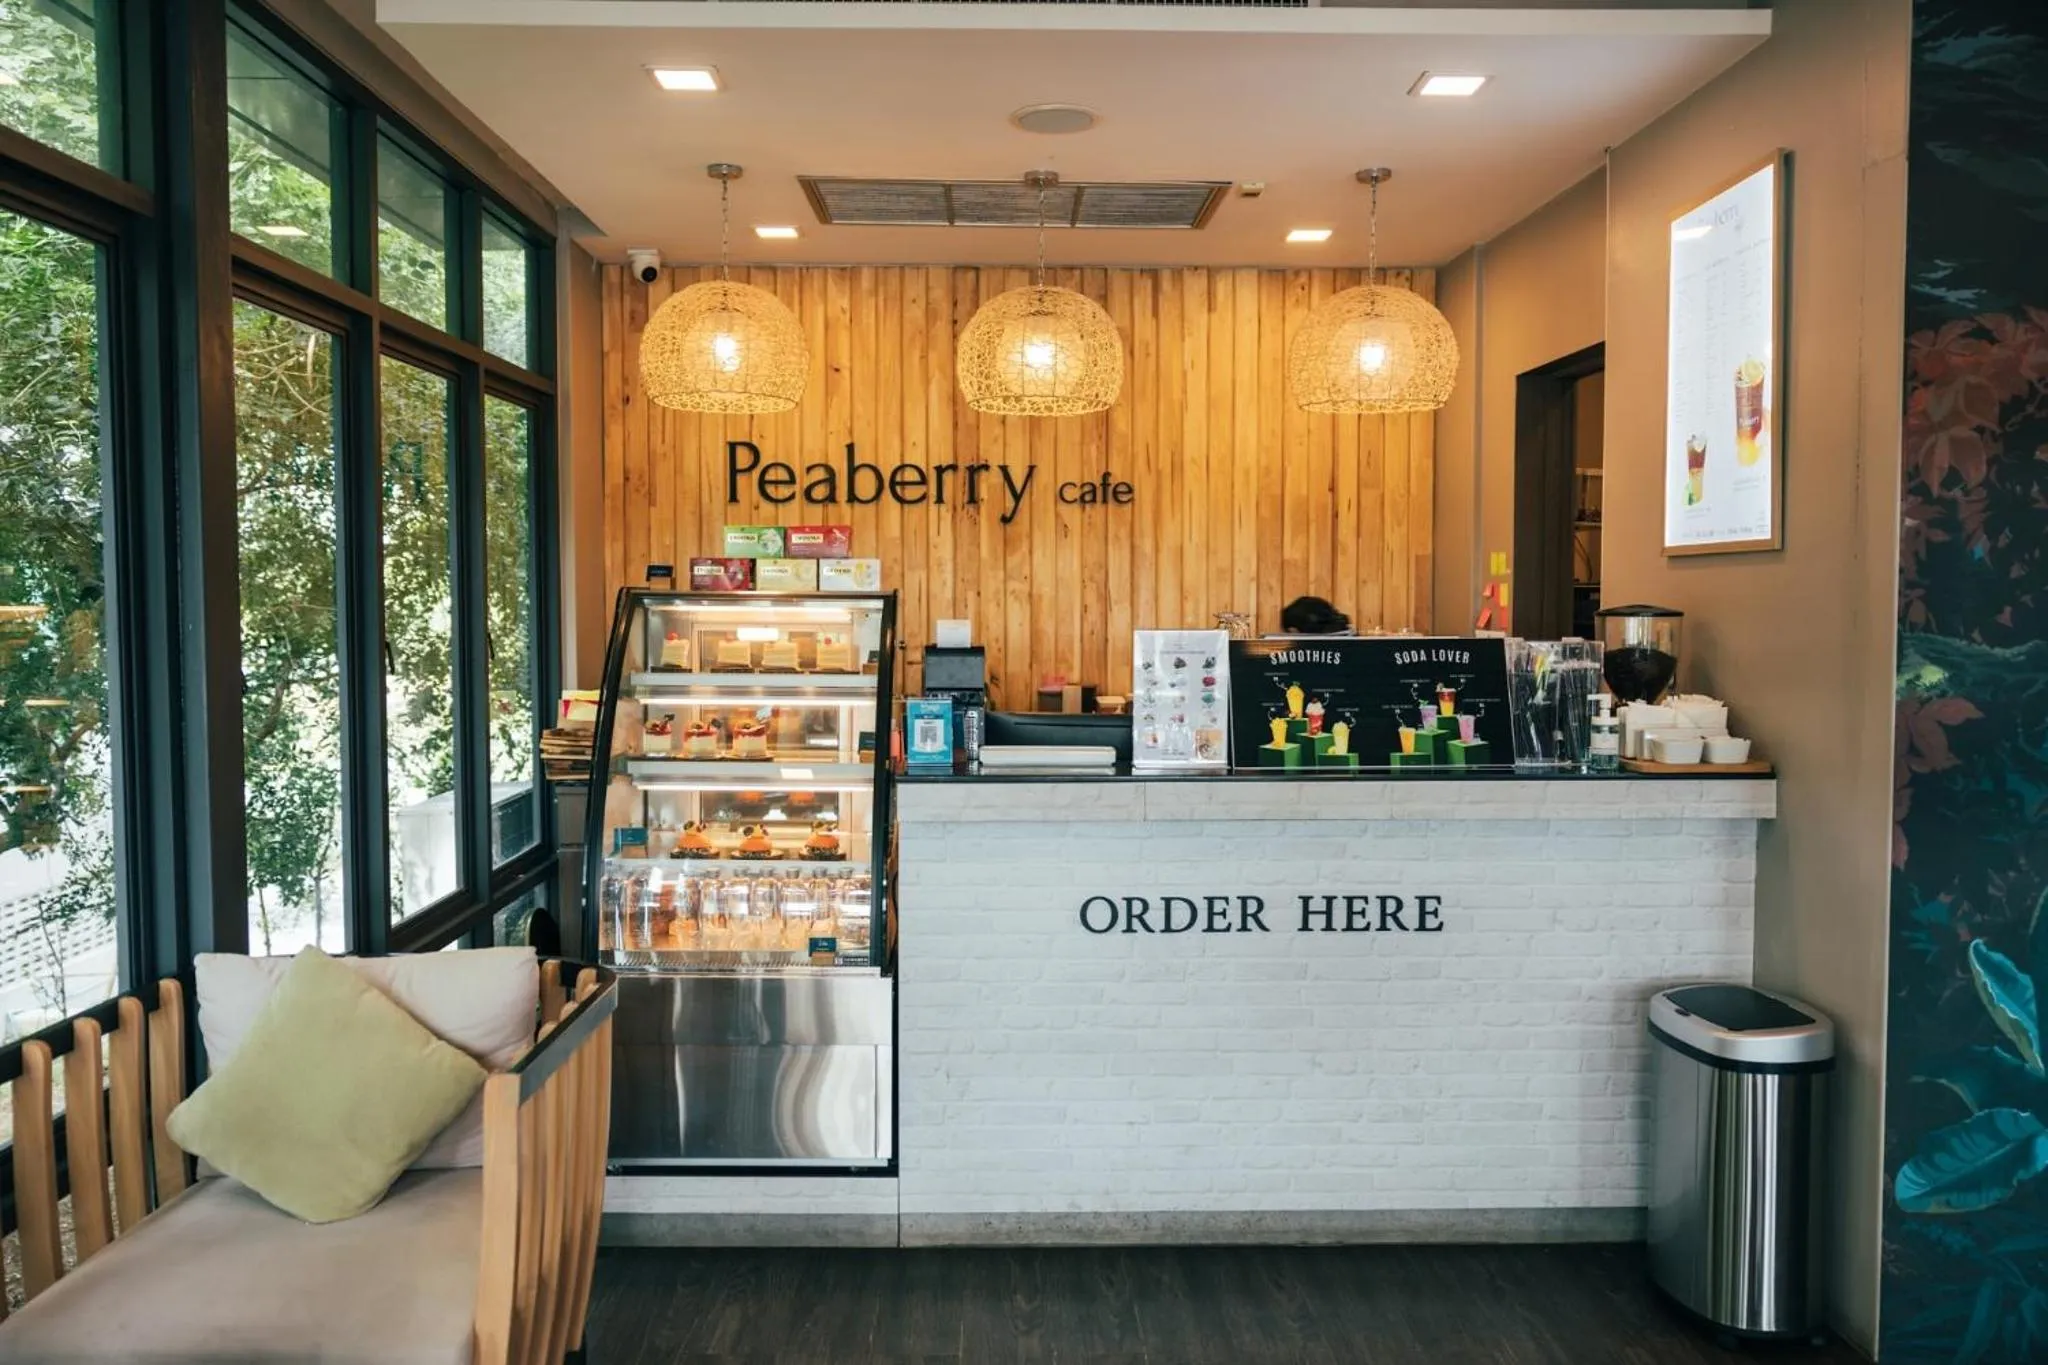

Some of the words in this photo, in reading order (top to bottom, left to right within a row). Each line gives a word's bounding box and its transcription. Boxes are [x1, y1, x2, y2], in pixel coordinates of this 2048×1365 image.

[726, 440, 1037, 526] Peaberry
[1058, 471, 1135, 505] cafe
[1270, 649, 1341, 666] SMOOTHIES
[1394, 649, 1427, 666] SODA
[1432, 649, 1470, 665] LOVER
[1079, 895, 1271, 934] ORDER
[1297, 895, 1444, 933] HERE
